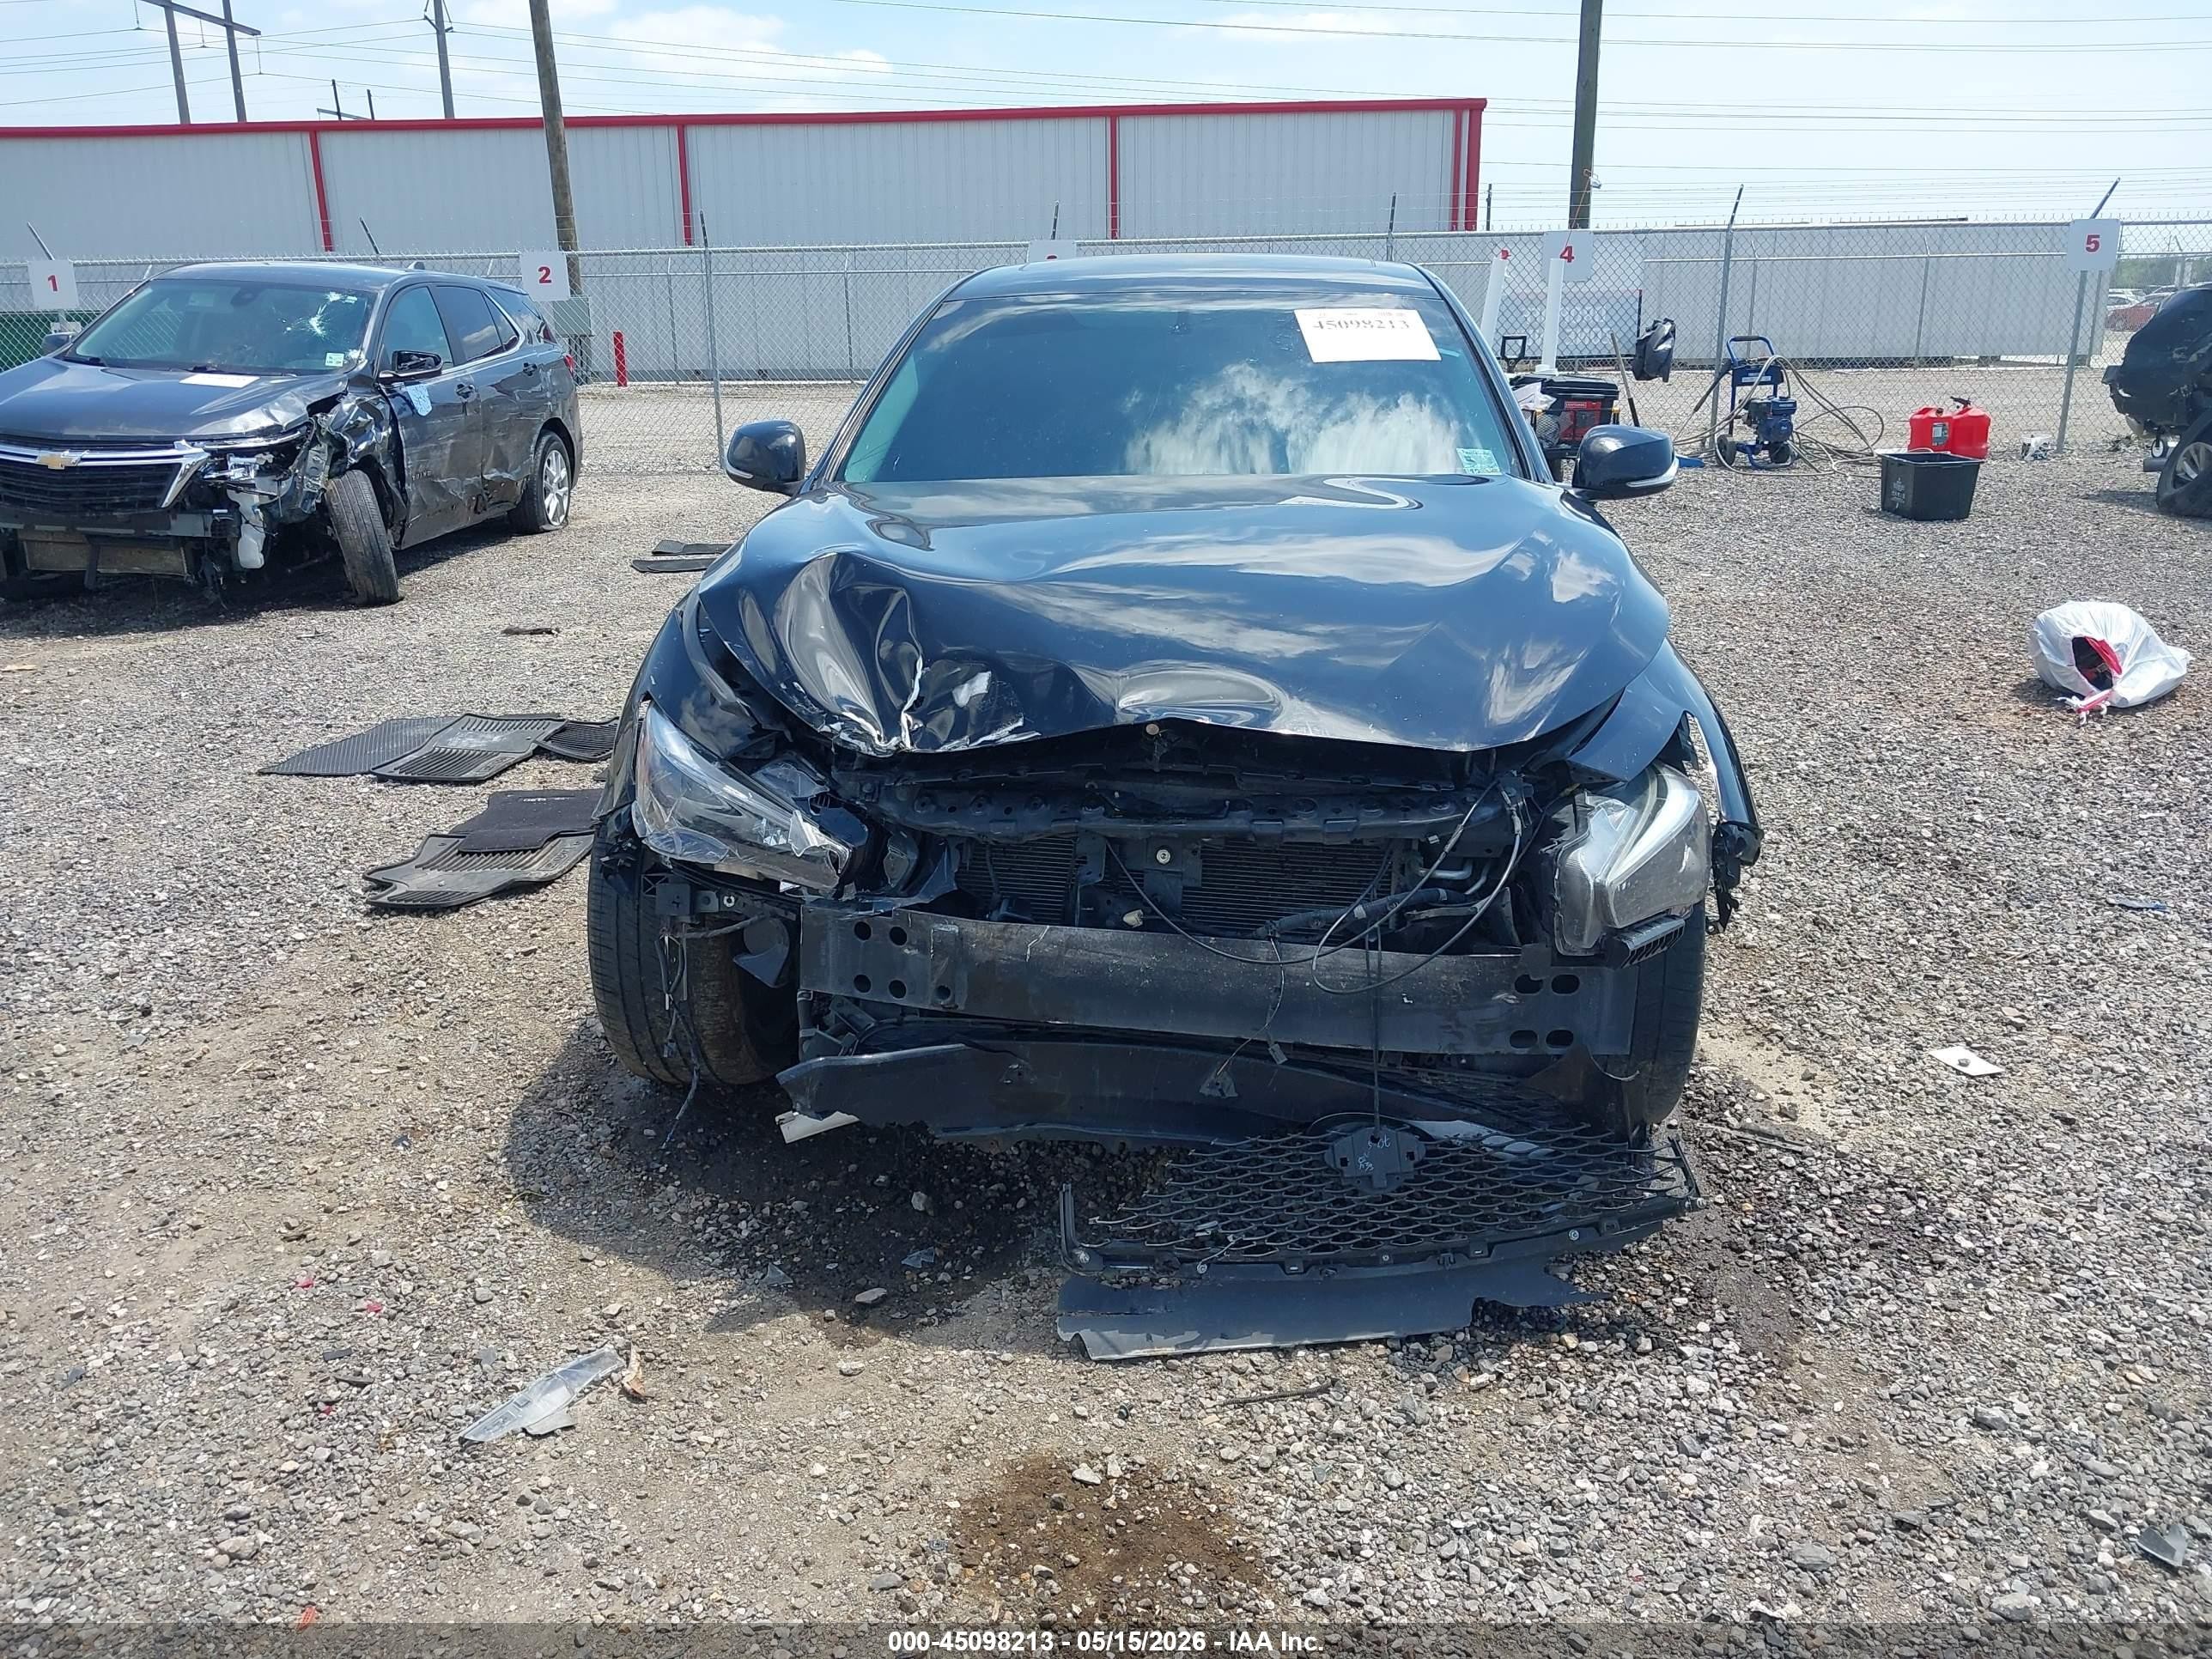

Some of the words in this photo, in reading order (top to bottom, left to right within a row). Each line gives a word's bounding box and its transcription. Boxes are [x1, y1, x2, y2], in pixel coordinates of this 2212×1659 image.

[2085, 234, 2100, 252] 5
[1559, 246, 1575, 263] 4
[47, 274, 58, 292] 1
[538, 266, 552, 283] 2
